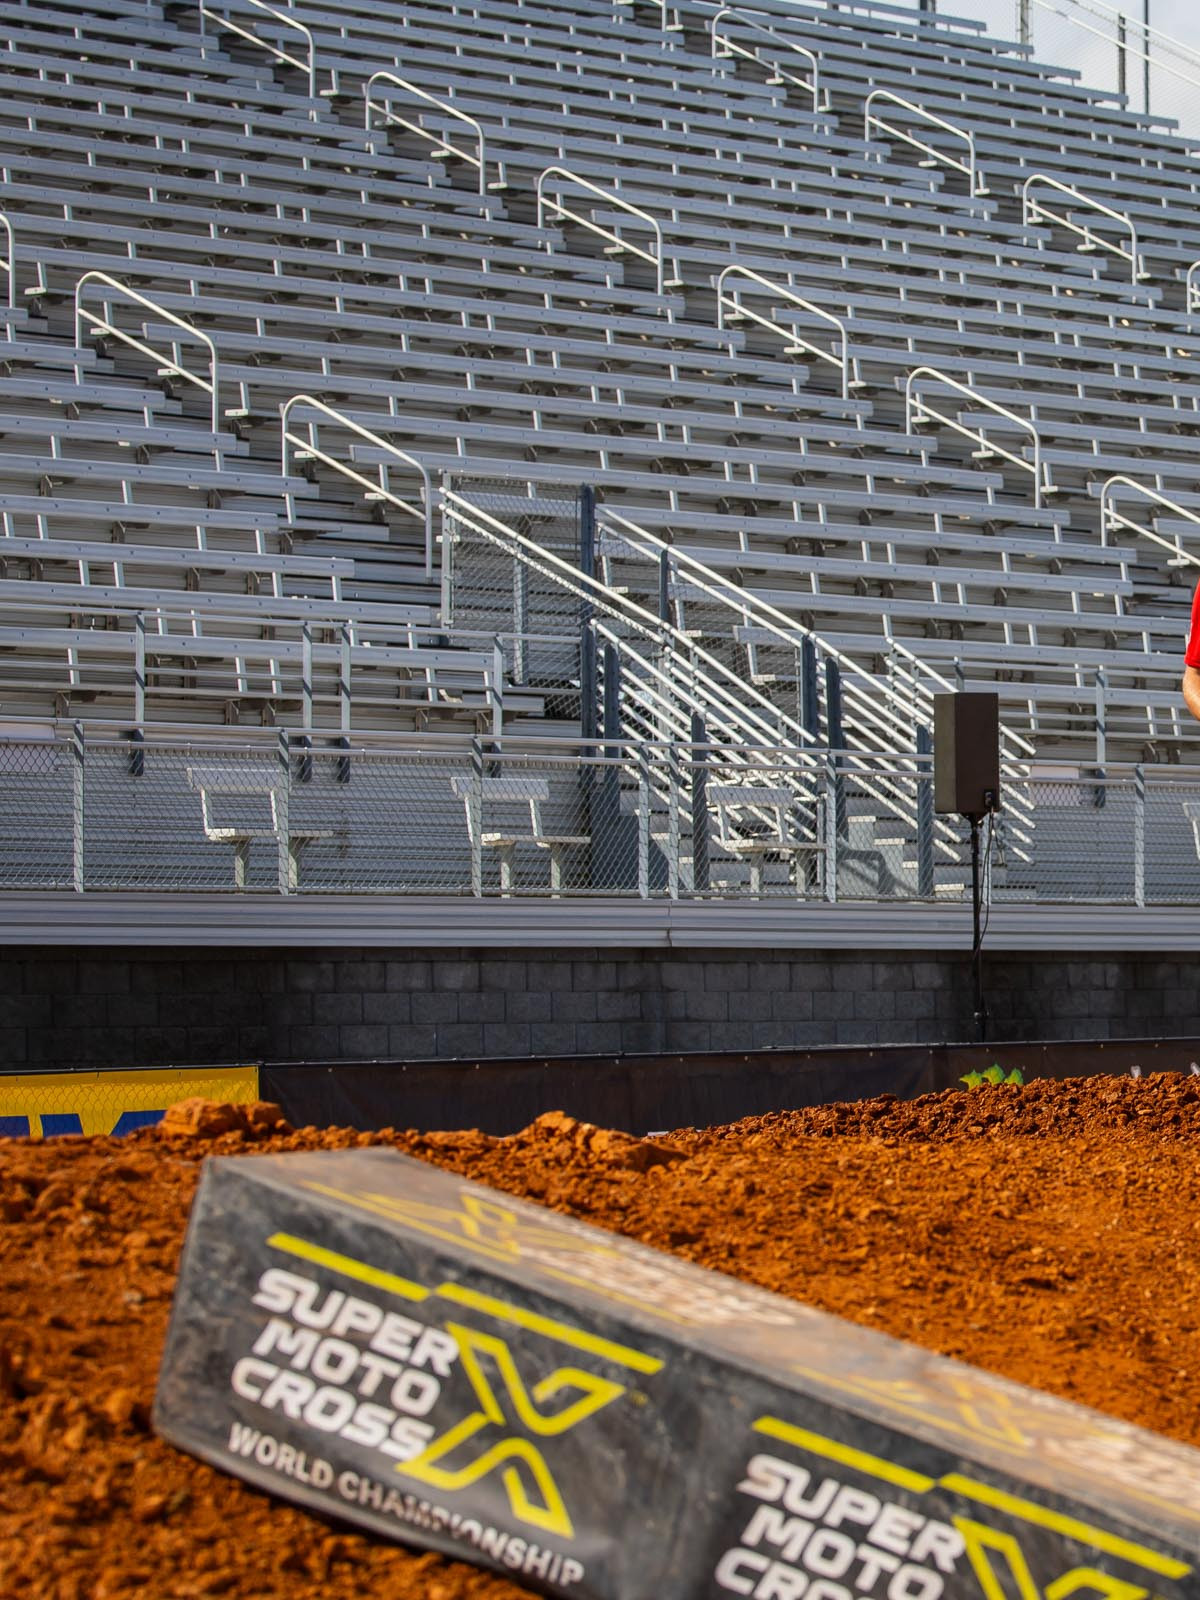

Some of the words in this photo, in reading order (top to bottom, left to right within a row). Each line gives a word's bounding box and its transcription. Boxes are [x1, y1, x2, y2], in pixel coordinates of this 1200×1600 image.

[252, 1267, 460, 1377] SUPER
[252, 1317, 442, 1417] MOTO
[231, 1356, 436, 1461] CROSS
[228, 1421, 334, 1490] WORLD
[337, 1471, 585, 1588] CHAMPIONSHIP
[736, 1453, 967, 1574] SUPER
[740, 1504, 945, 1600] MOTO
